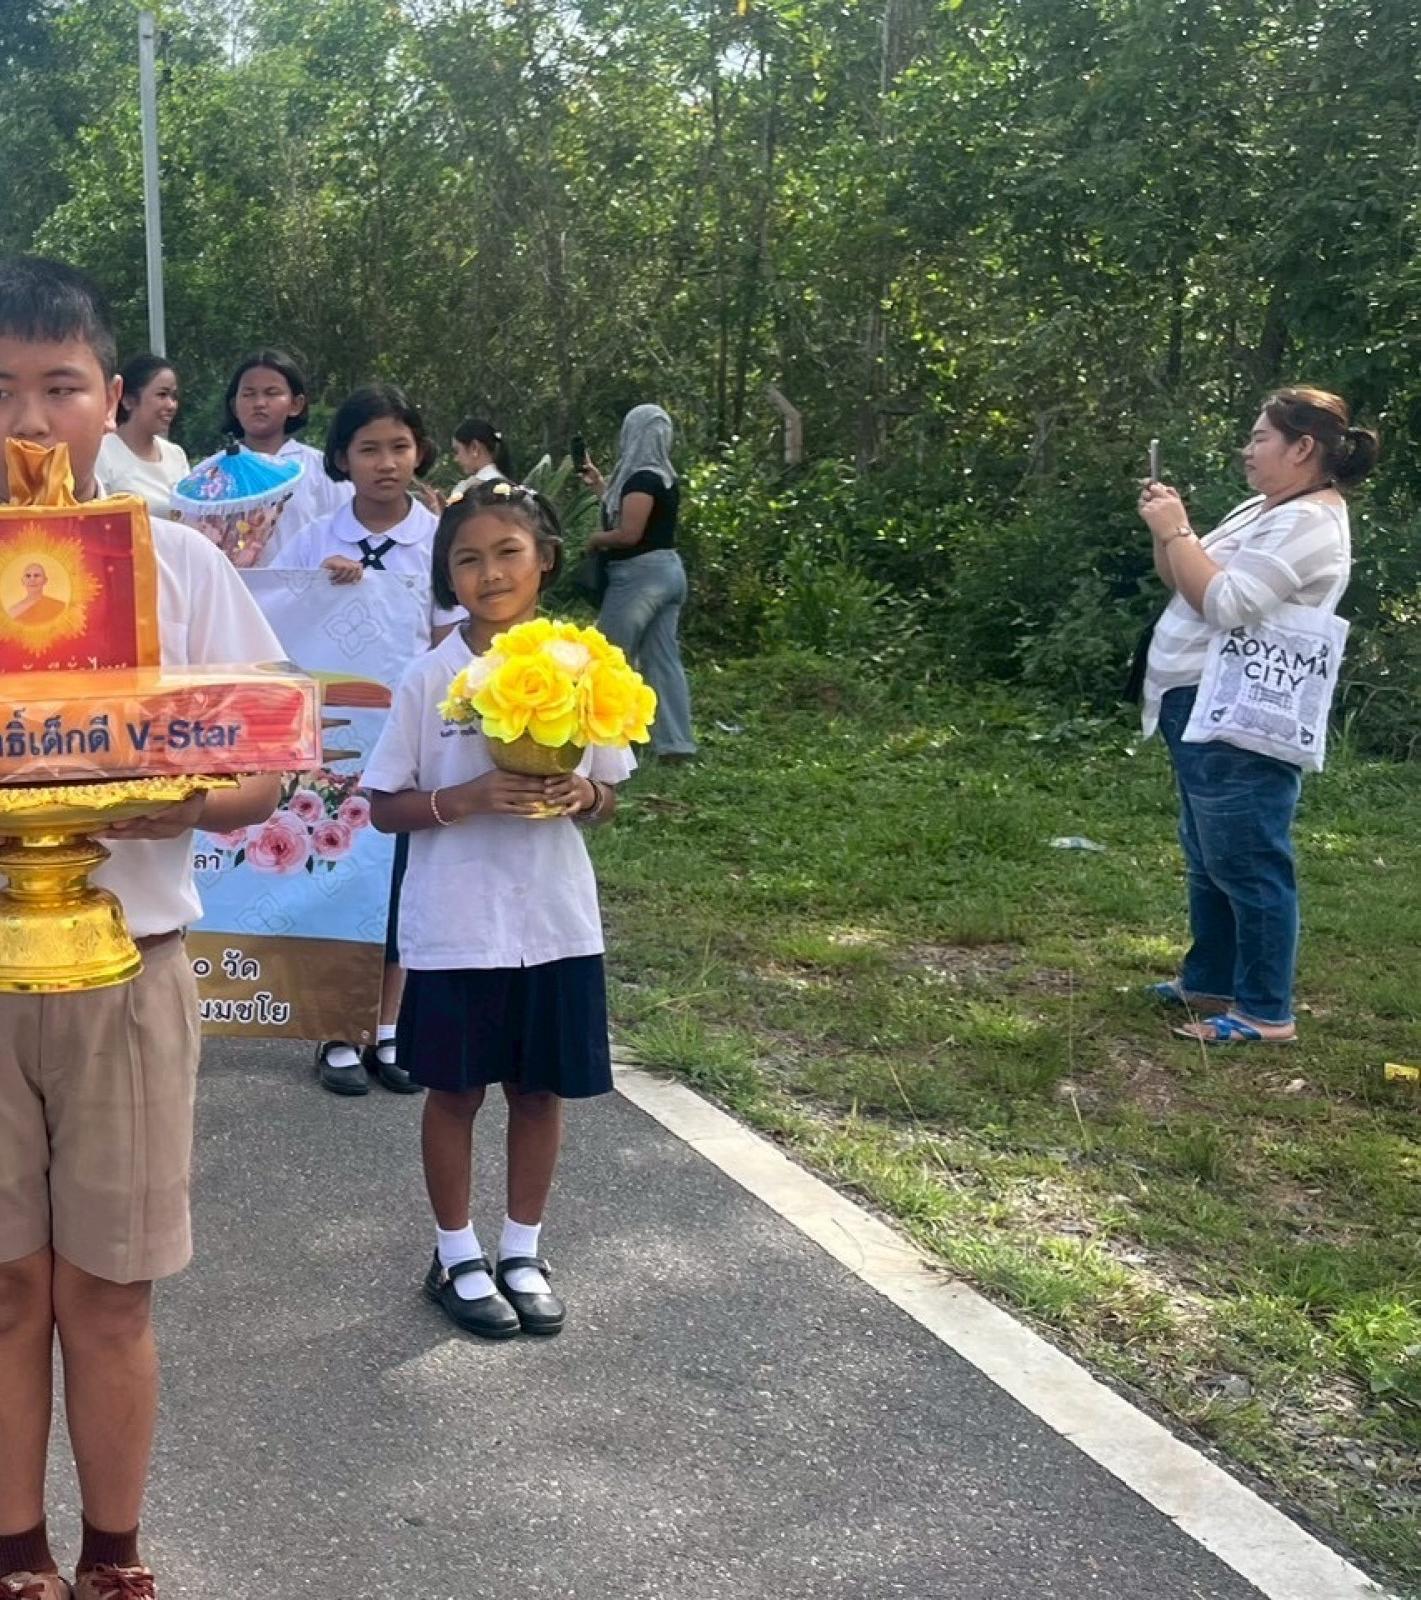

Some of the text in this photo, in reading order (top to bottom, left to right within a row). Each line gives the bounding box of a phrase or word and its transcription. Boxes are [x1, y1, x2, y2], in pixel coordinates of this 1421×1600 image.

[1220, 639, 1327, 679] AOYAMA
[1245, 661, 1305, 690] CITY
[127, 718, 241, 751] V-Star
[223, 951, 259, 978] วัด
